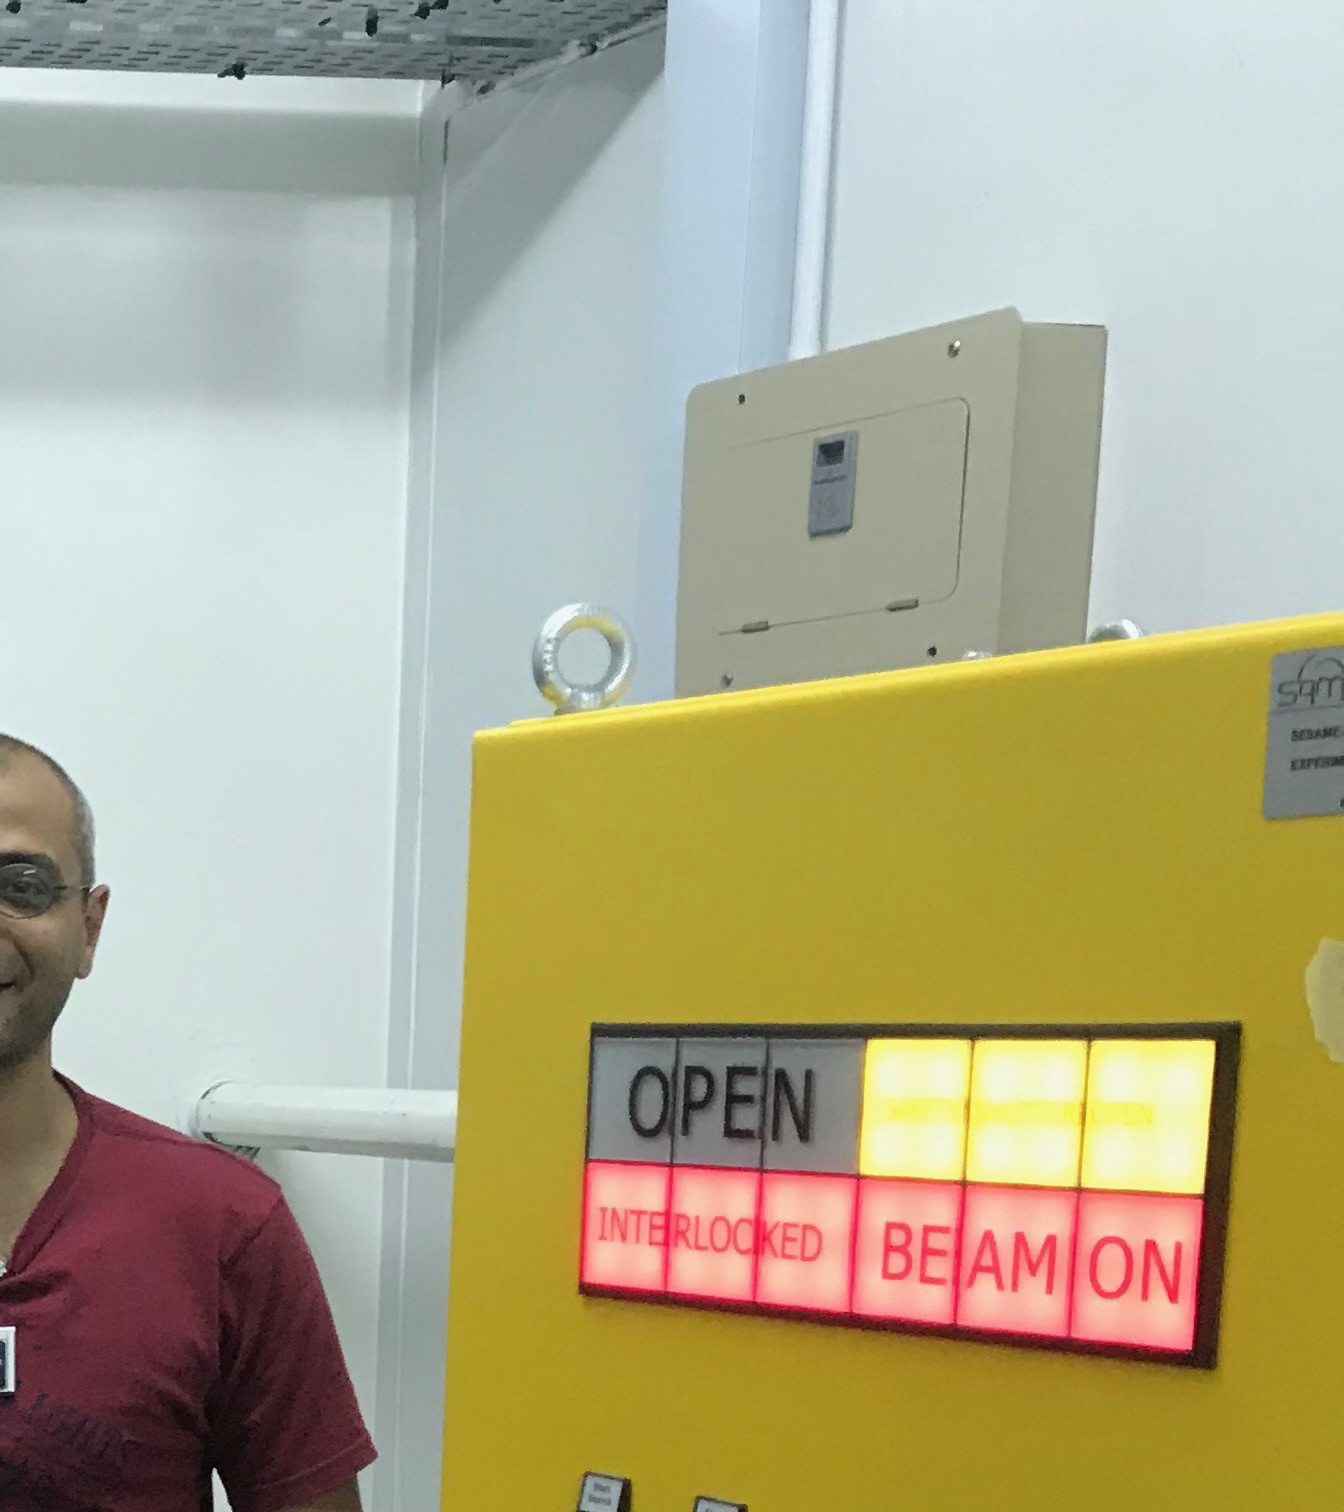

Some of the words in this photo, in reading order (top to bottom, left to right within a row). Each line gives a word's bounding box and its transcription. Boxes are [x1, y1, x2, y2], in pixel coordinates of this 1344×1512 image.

[628, 1064, 816, 1144] OPEN
[597, 1205, 824, 1265] INTERLOCKED
[880, 1221, 1058, 1297] BEAM
[1088, 1235, 1182, 1306] ON
